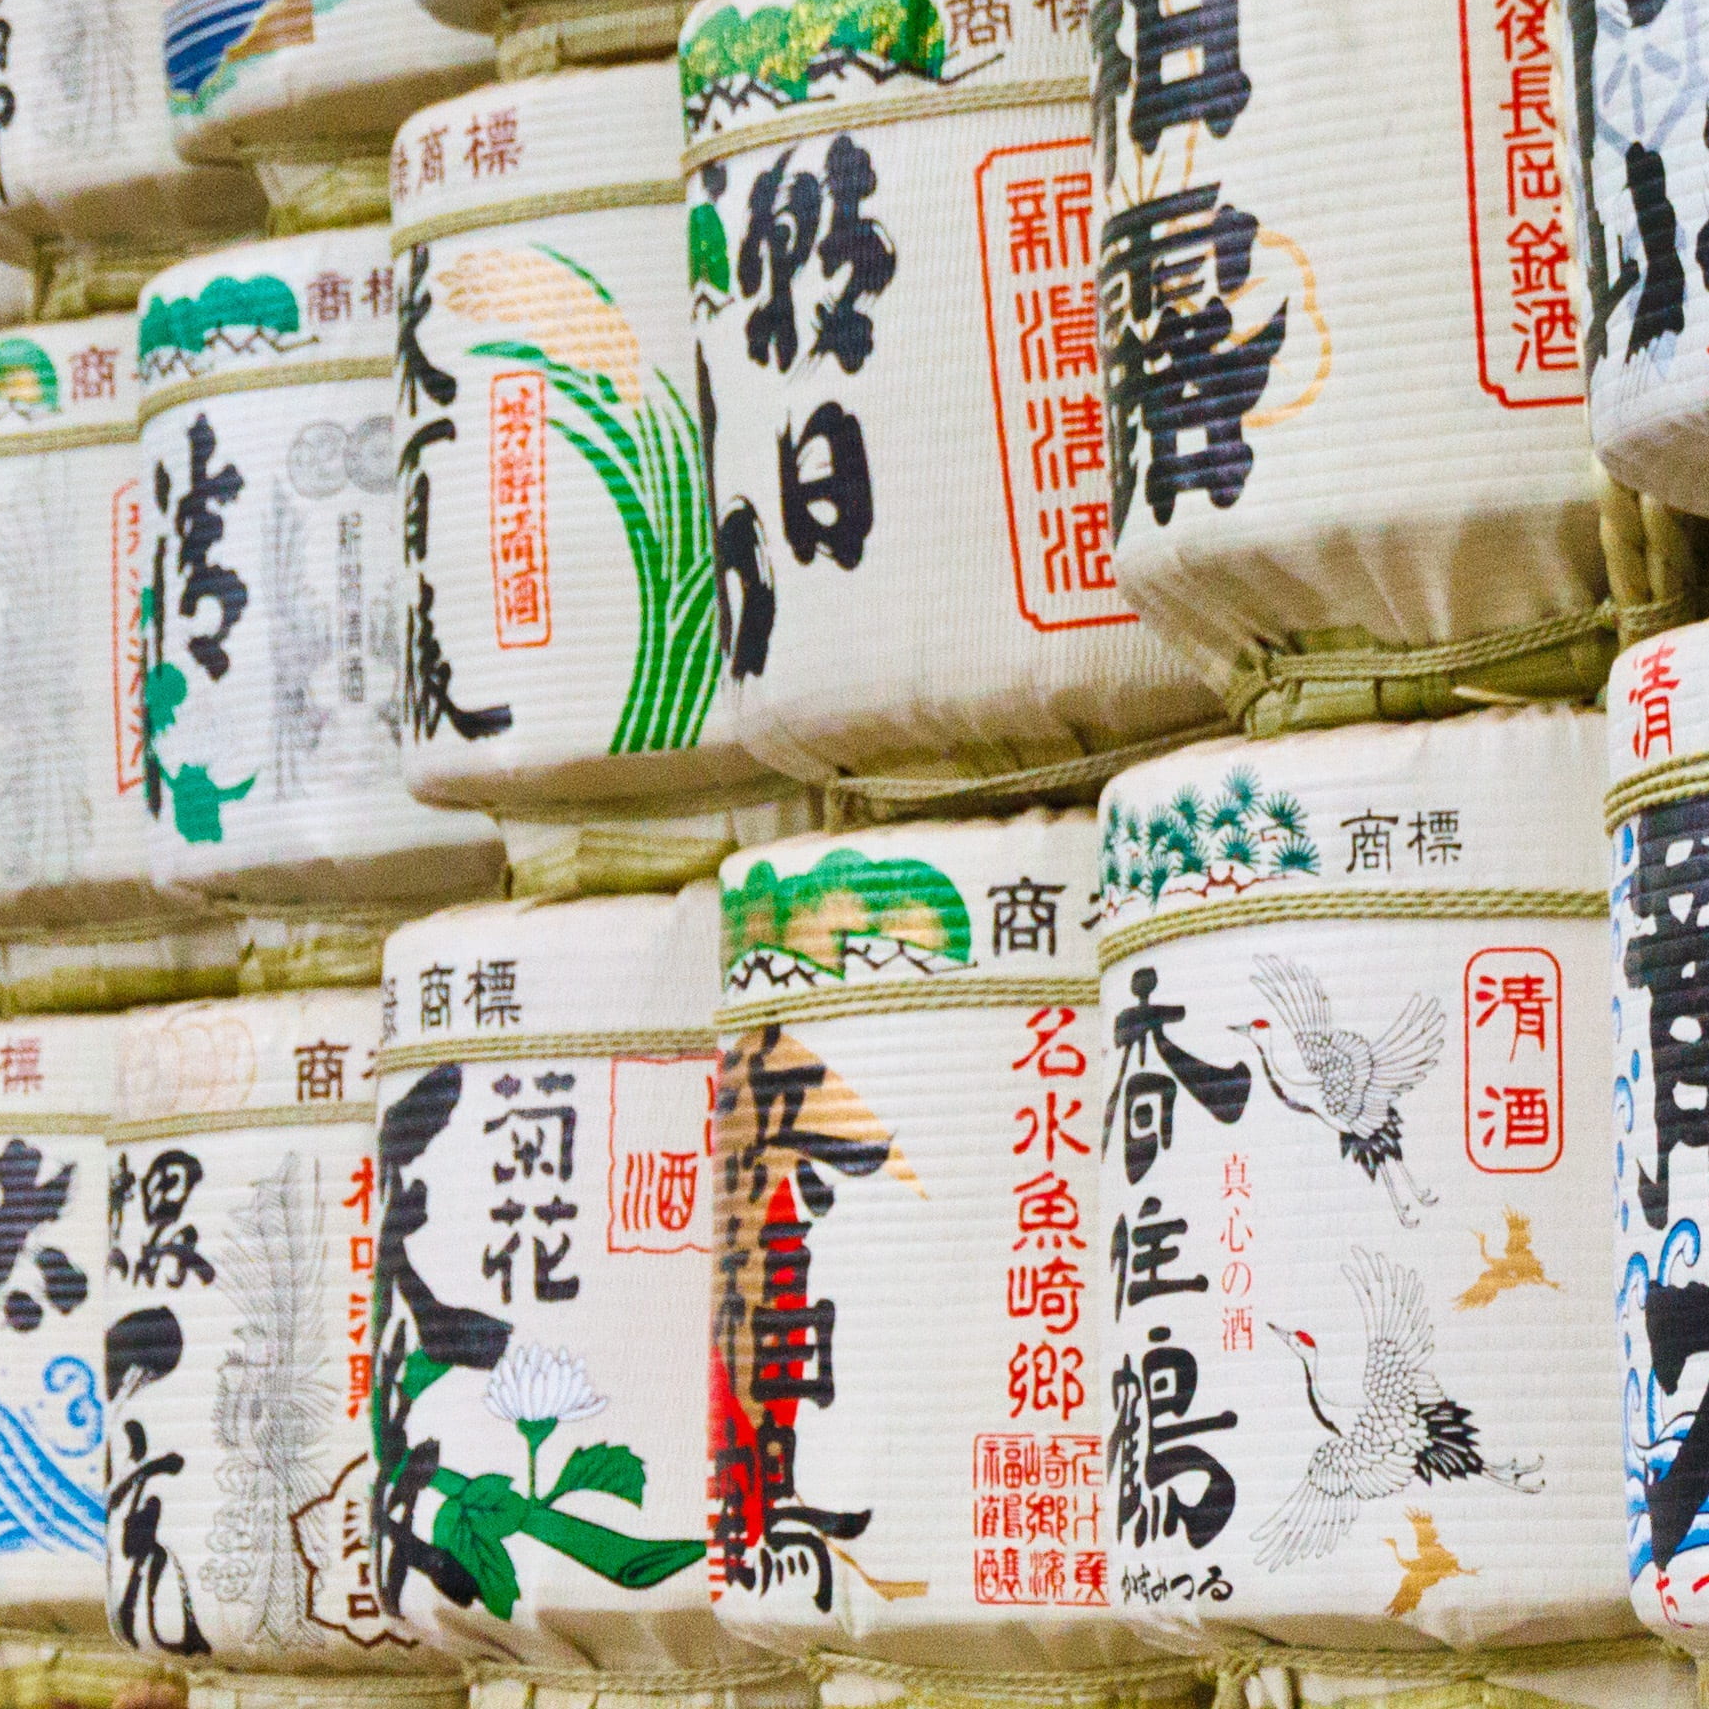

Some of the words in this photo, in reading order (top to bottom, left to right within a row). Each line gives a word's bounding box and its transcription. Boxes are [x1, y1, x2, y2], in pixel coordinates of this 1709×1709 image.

[1341, 809, 1463, 873] 商標
[1476, 974, 1552, 1149] 清酒
[482, 1072, 579, 1303] 菊花
[1006, 1008, 1091, 1421] 名水魚崎郷
[1102, 967, 1251, 1548] 香住鶴
[1219, 1152, 1254, 1352] 真心の酒
